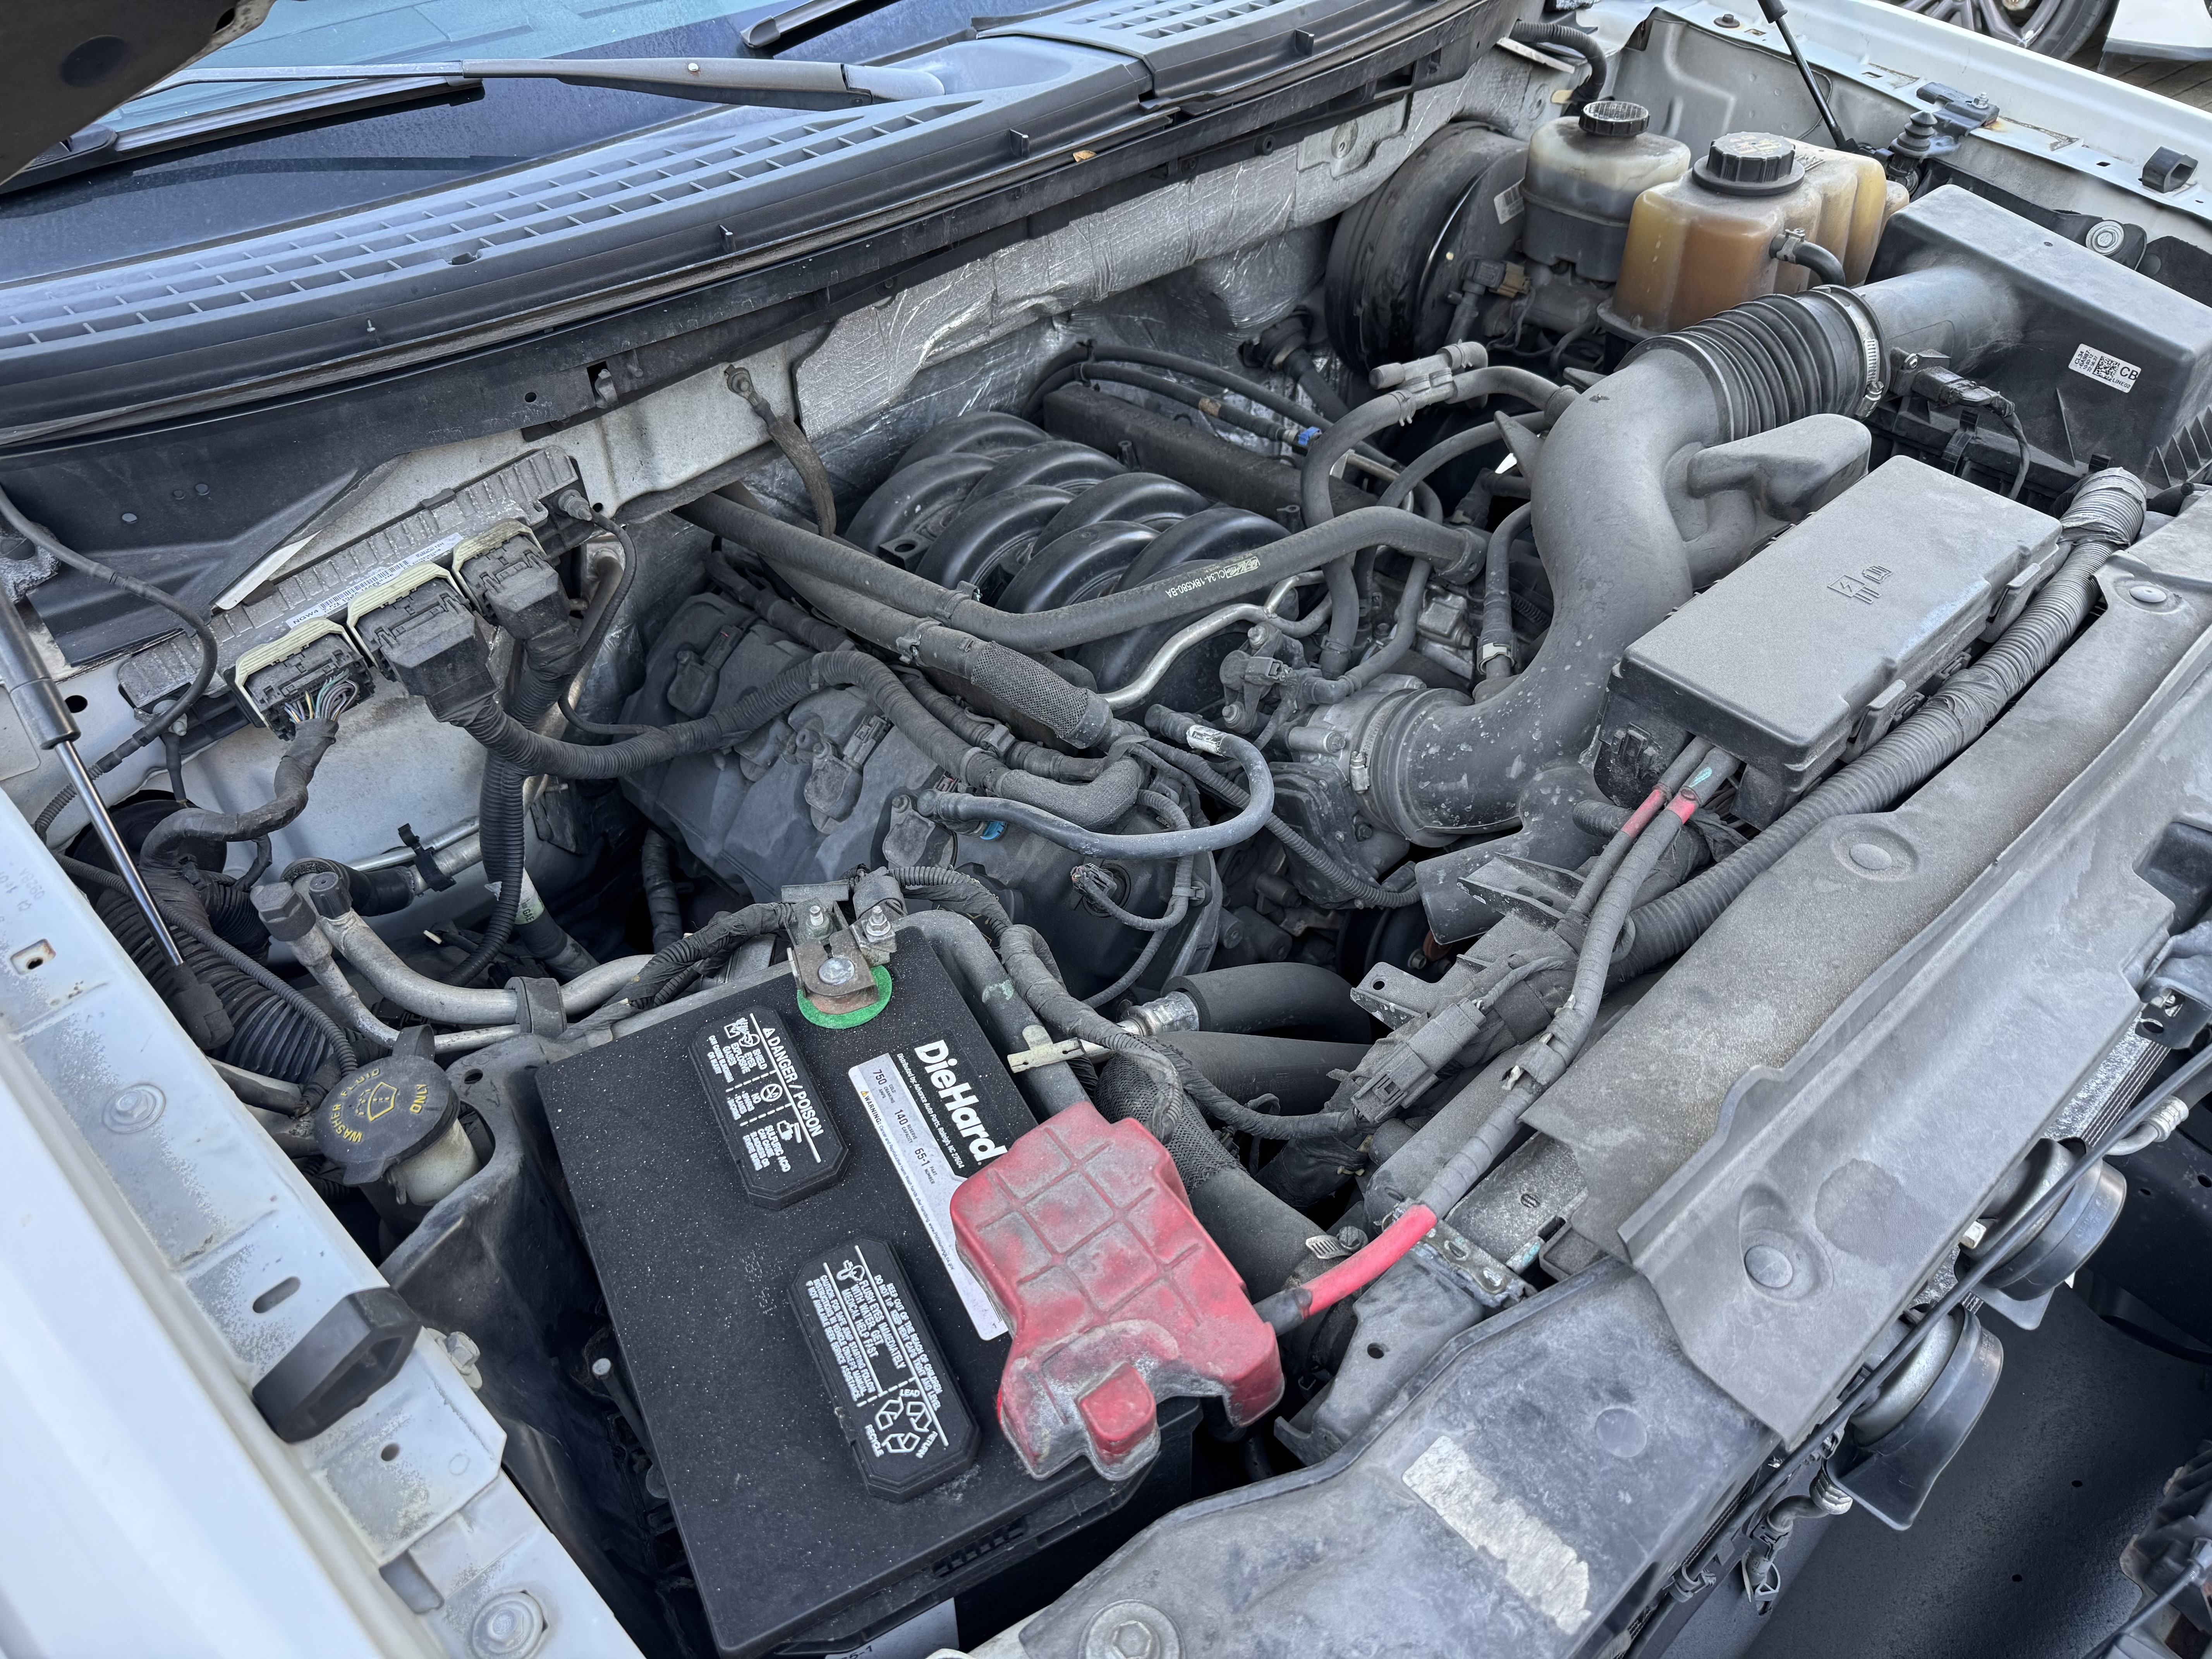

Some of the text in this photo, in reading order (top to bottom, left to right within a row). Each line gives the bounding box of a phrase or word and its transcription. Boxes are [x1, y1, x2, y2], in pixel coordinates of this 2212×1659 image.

[2075, 351, 2084, 364] CL34
[2120, 366, 2138, 380] CB
[2112, 378, 2131, 389] LINE02
[1165, 570, 1226, 598] CL34-18K580-BA
[293, 610, 319, 625] NGW4
[722, 1046, 737, 1066] GASES
[730, 1042, 751, 1074] EXPLOSIVE
[744, 1051, 757, 1068] EYES
[752, 1048, 768, 1070] SHIELD
[896, 1053, 915, 1077] Distributed
[872, 1069, 887, 1085] 750
[768, 1036, 798, 1083] DANGER
[793, 1091, 824, 1137] POISON
[878, 1089, 886, 1099] AMPS
[883, 1086, 895, 1104] CRANKING
[913, 1084, 927, 1103] Advance
[331, 1068, 380, 1142] WASHER FLUID
[410, 1084, 428, 1113] ONLY
[750, 1092, 762, 1104] NO
[914, 1039, 1008, 1161] DieHard
[864, 1096, 881, 1125] WARNING:
[894, 1109, 908, 1125] 140
[924, 1103, 934, 1114] Auto
[930, 1114, 941, 1128] Parts,
[901, 1127, 914, 1143] CAPACITY
[907, 1124, 918, 1140] RESERVE
[937, 1127, 951, 1146] Raleigh,
[757, 1128, 775, 1158] CAN CAUSE
[764, 1125, 791, 1172] SULFURIC ACID
[947, 1145, 956, 1153] NC
[761, 1158, 770, 1168] OR
[914, 1148, 931, 1166] 65-1
[951, 1152, 965, 1168] 27604
[924, 1168, 935, 1185] NUMBER
[929, 1166, 938, 1176] PART
[874, 1274, 883, 1285] DO
[808, 1286, 819, 1299] NOT
[813, 1278, 836, 1317] INSTRUCTIONS
[878, 1284, 890, 1297] NOT
[813, 1299, 831, 1328] AVAILABLE
[830, 1299, 841, 1312] FOR
[829, 1316, 837, 1324] IN
[835, 1311, 847, 1327] SAFE
[842, 1288, 879, 1358] MEDICAL HELP FAST
[850, 1284, 865, 1304] WITH
[871, 1330, 884, 1345] GET
[890, 1309, 903, 1325] KEEP
[859, 1279, 906, 1369] FLUSH EYES IMMEDIATELY
[824, 1326, 836, 1342] SEEK
[832, 1323, 848, 1346] VEHICLE
[842, 1326, 854, 1341] JUMP
[886, 1283, 943, 1395] KEEP OUT OF THE REACH OF CHILDREN
[898, 1325, 910, 1341] VENT
[831, 1341, 846, 1365] SERVICE
[848, 1341, 866, 1369] STARTING
[905, 1341, 918, 1358] CAPS
[913, 1357, 926, 1376] TIGHT
[860, 1369, 876, 1393] FOLLOW
[921, 1377, 933, 1391] AND
[900, 1388, 921, 1398] LEAD
[927, 1390, 941, 1411] LEVEL
[864, 1424, 884, 1457] RECYCLE
[915, 1430, 937, 1459] RETURN
[842, 1645, 873, 1659] 5-1
